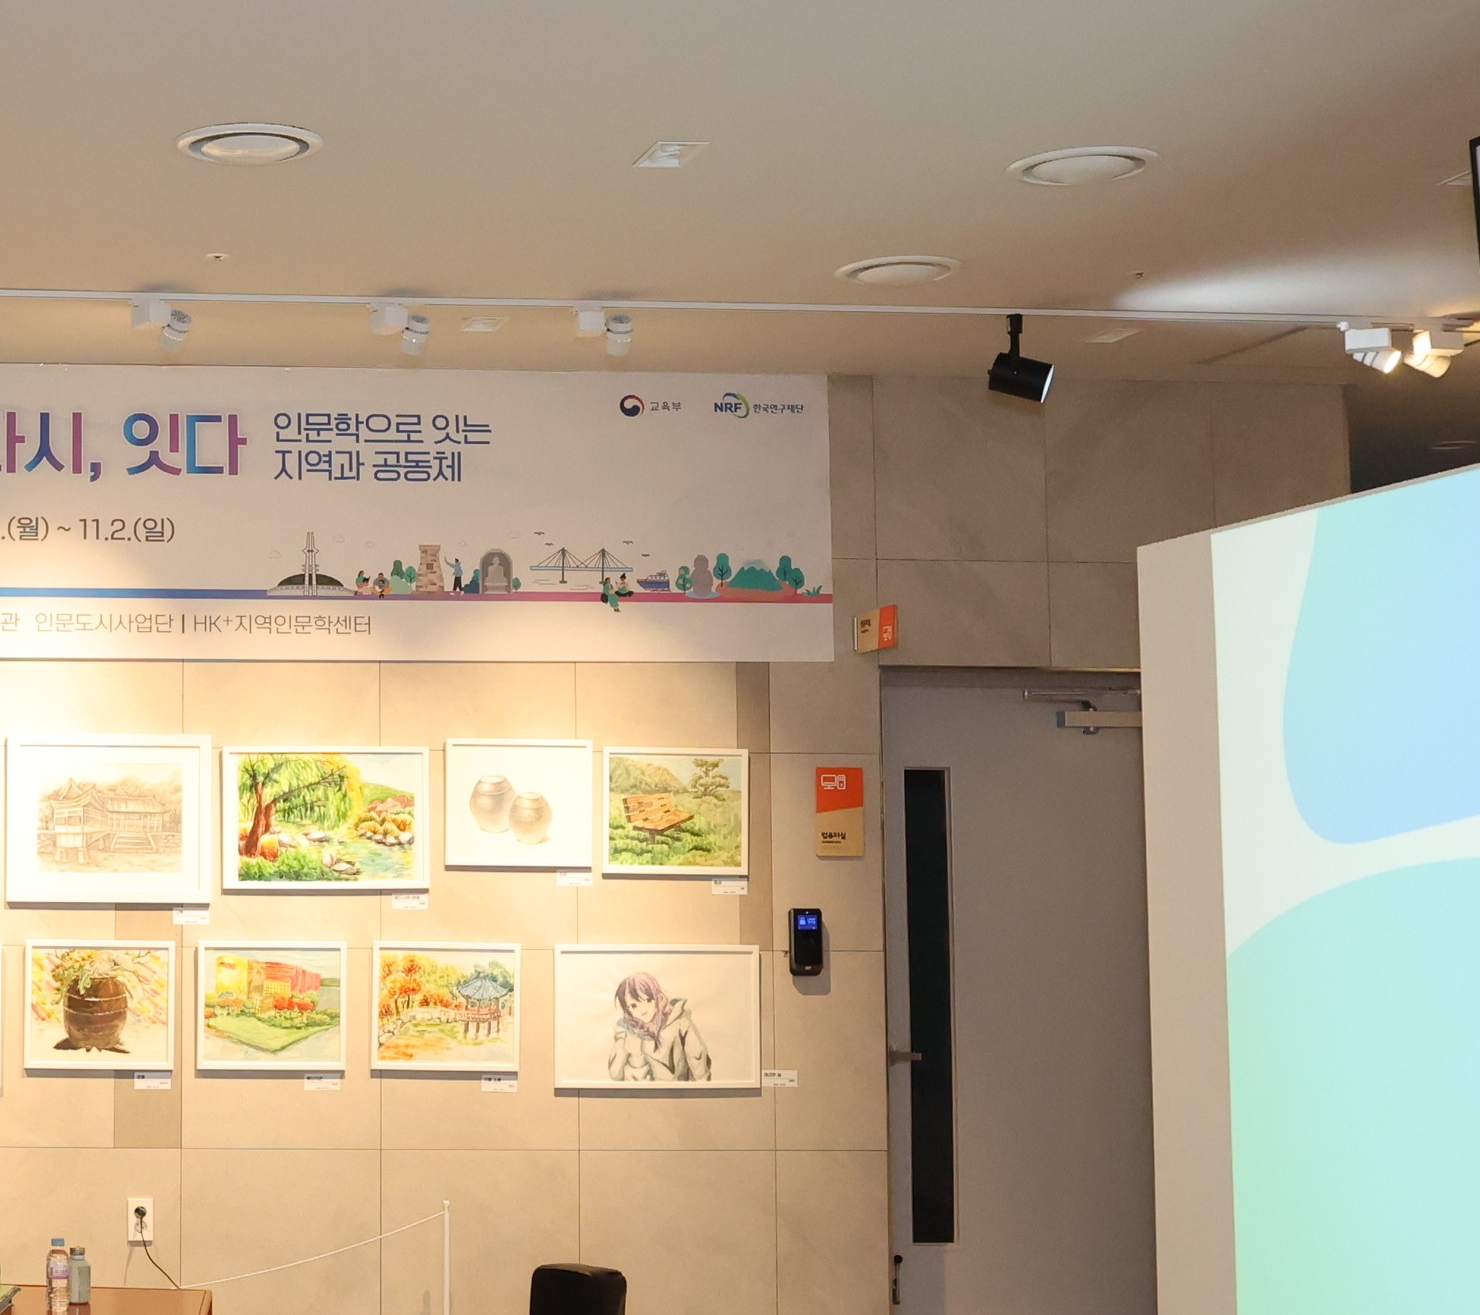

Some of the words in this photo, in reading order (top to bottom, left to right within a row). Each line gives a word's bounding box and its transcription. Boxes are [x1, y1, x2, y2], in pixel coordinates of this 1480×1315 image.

[649, 401, 682, 412] 교육부
[714, 402, 743, 413] NRF
[752, 403, 805, 415] 한국연구재단
[273, 412, 425, 446] 인문학으로
[431, 413, 492, 445] 잇는
[123, 412, 248, 477] 잇다
[273, 449, 365, 482] 지역과
[371, 450, 463, 483] 공동체
[77, 517, 176, 544] 11.2.(일)
[34, 611, 175, 634] 인문도시사업단
[193, 614, 372, 636] HK+지역인문학센터
